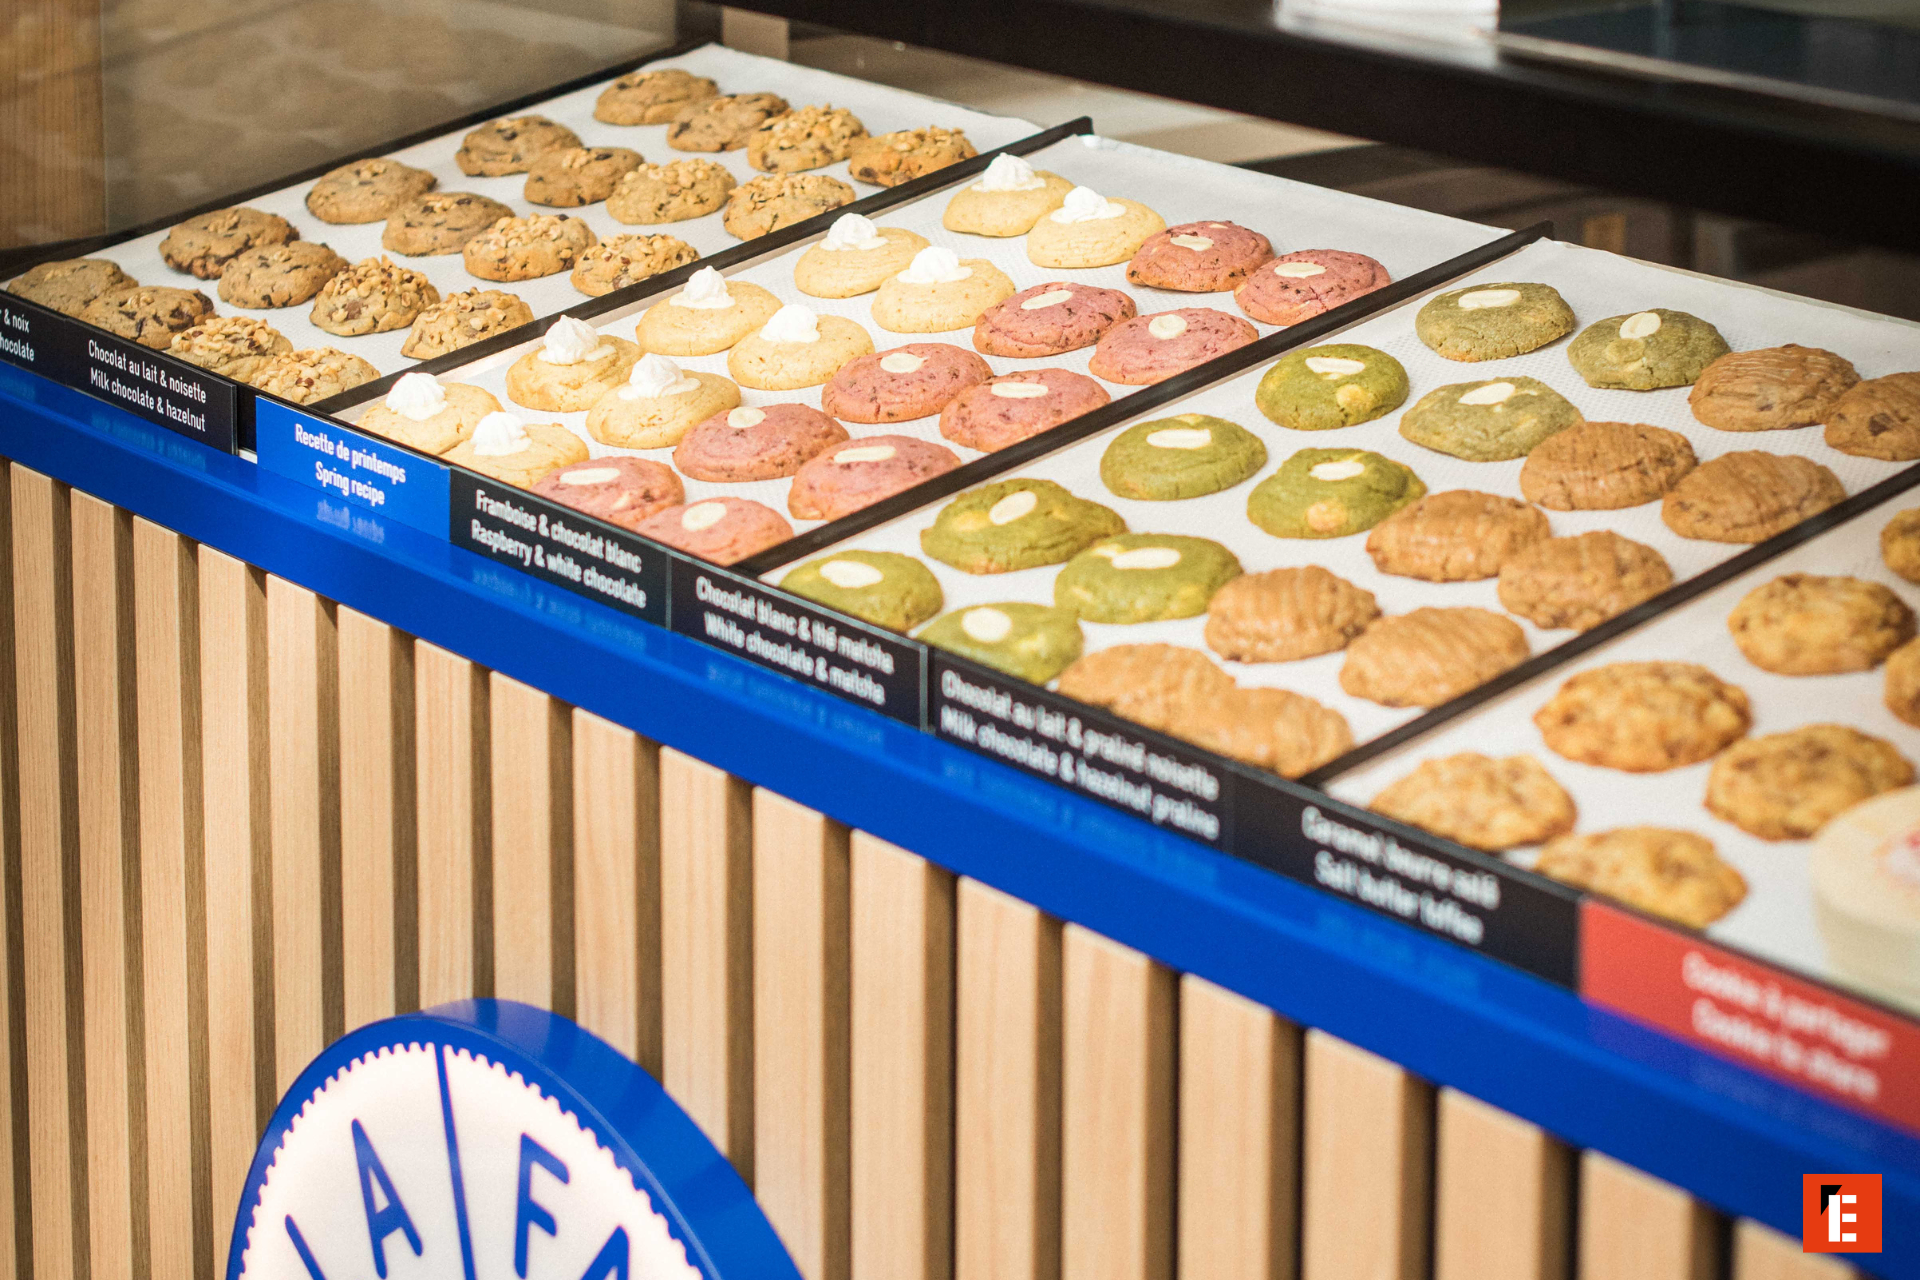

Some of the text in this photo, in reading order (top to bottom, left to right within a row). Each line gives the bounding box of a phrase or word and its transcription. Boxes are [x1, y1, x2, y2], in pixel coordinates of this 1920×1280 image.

[0, 331, 35, 361] hocolate
[4, 308, 11, 326] &
[12, 314, 30, 333] noix
[88, 339, 207, 403] Chocolat au lait & noisette
[90, 367, 206, 432] Milk chocolate & hazelnut
[295, 423, 407, 485] Recette de printemps
[315, 461, 385, 507] Spring recipe
[471, 518, 647, 609] Raspberry & white chocolate
[476, 489, 642, 574] Framboise & chocolat blanc
[696, 575, 755, 620] Chocolat
[757, 598, 797, 636] blanc
[798, 616, 811, 643] &
[838, 635, 895, 675] matcha
[704, 611, 886, 706] White chocolate & matcha
[940, 704, 978, 744] Milk
[977, 722, 1059, 776] chocolate
[1058, 751, 1076, 783] &
[1076, 757, 1153, 814] hazelnut
[941, 669, 1012, 721] Chocolat
[1011, 702, 1036, 730] au
[1035, 704, 1067, 742] lait
[1066, 717, 1083, 749] &
[1145, 752, 1219, 802] noisette
